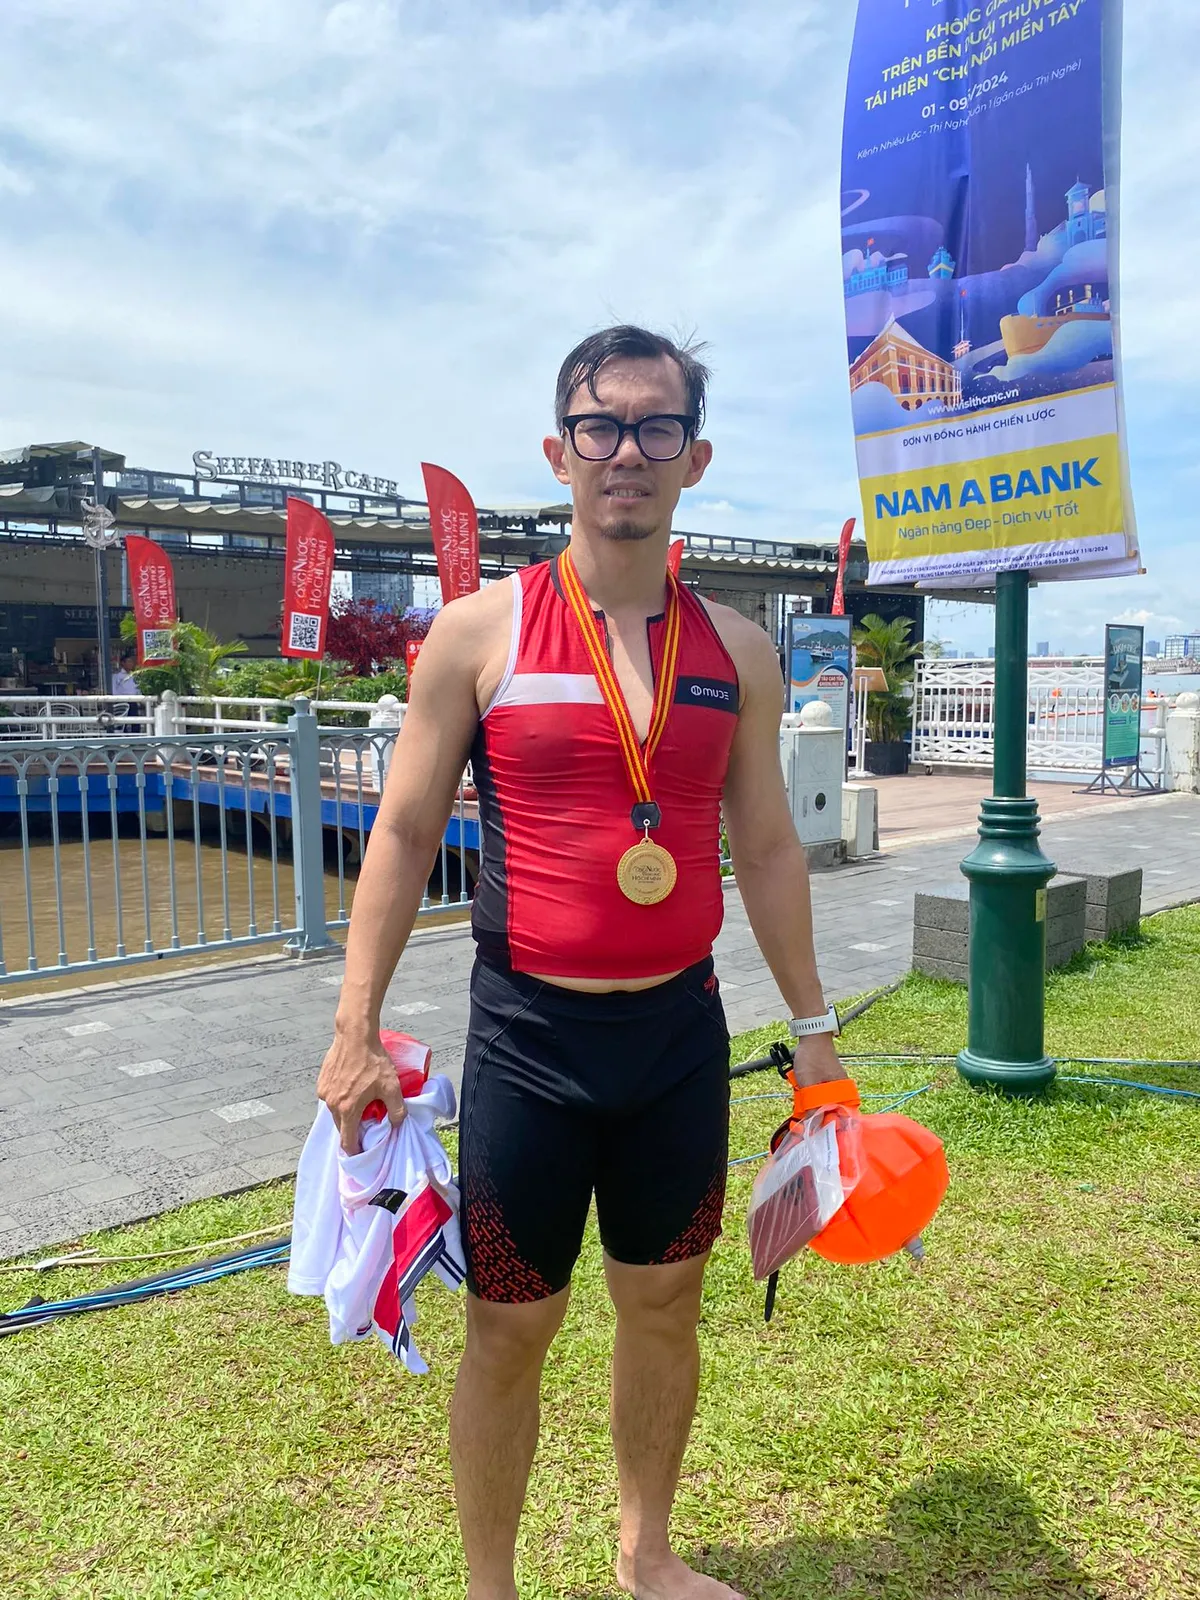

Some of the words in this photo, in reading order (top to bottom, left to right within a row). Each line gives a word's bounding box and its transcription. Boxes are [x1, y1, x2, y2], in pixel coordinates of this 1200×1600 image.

[925, 8, 982, 43] KHÔNG
[864, 89, 888, 111] TÁI
[891, 73, 929, 101] HIỆN
[971, 37, 997, 68] NỔI
[881, 53, 923, 83] TRÊN
[926, 38, 962, 64] BẾN
[920, 102, 936, 119] 01
[856, 144, 879, 160] Kênh
[927, 387, 1020, 416] www.visithcmc.vn
[902, 433, 922, 447] ĐƠN
[922, 431, 933, 444] VỊ
[933, 427, 964, 442] ĐỒNG
[965, 422, 992, 436] HÀNH
[993, 413, 1024, 429] CHIẾN
[1026, 407, 1056, 423] LƯỢC
[192, 450, 344, 492] SEEFAHRER
[344, 469, 400, 497] CAFE
[874, 482, 952, 520] NAM
[958, 478, 987, 508] A
[988, 456, 1103, 503] BANK
[459, 511, 470, 544] MINH
[897, 525, 930, 541] Ngân
[931, 519, 962, 537] hàng
[963, 516, 992, 532] Đẹp
[1001, 506, 1032, 526] Dịch
[1033, 508, 1052, 521] vụ
[1052, 499, 1079, 517] Tốt
[316, 539, 328, 567] MINH
